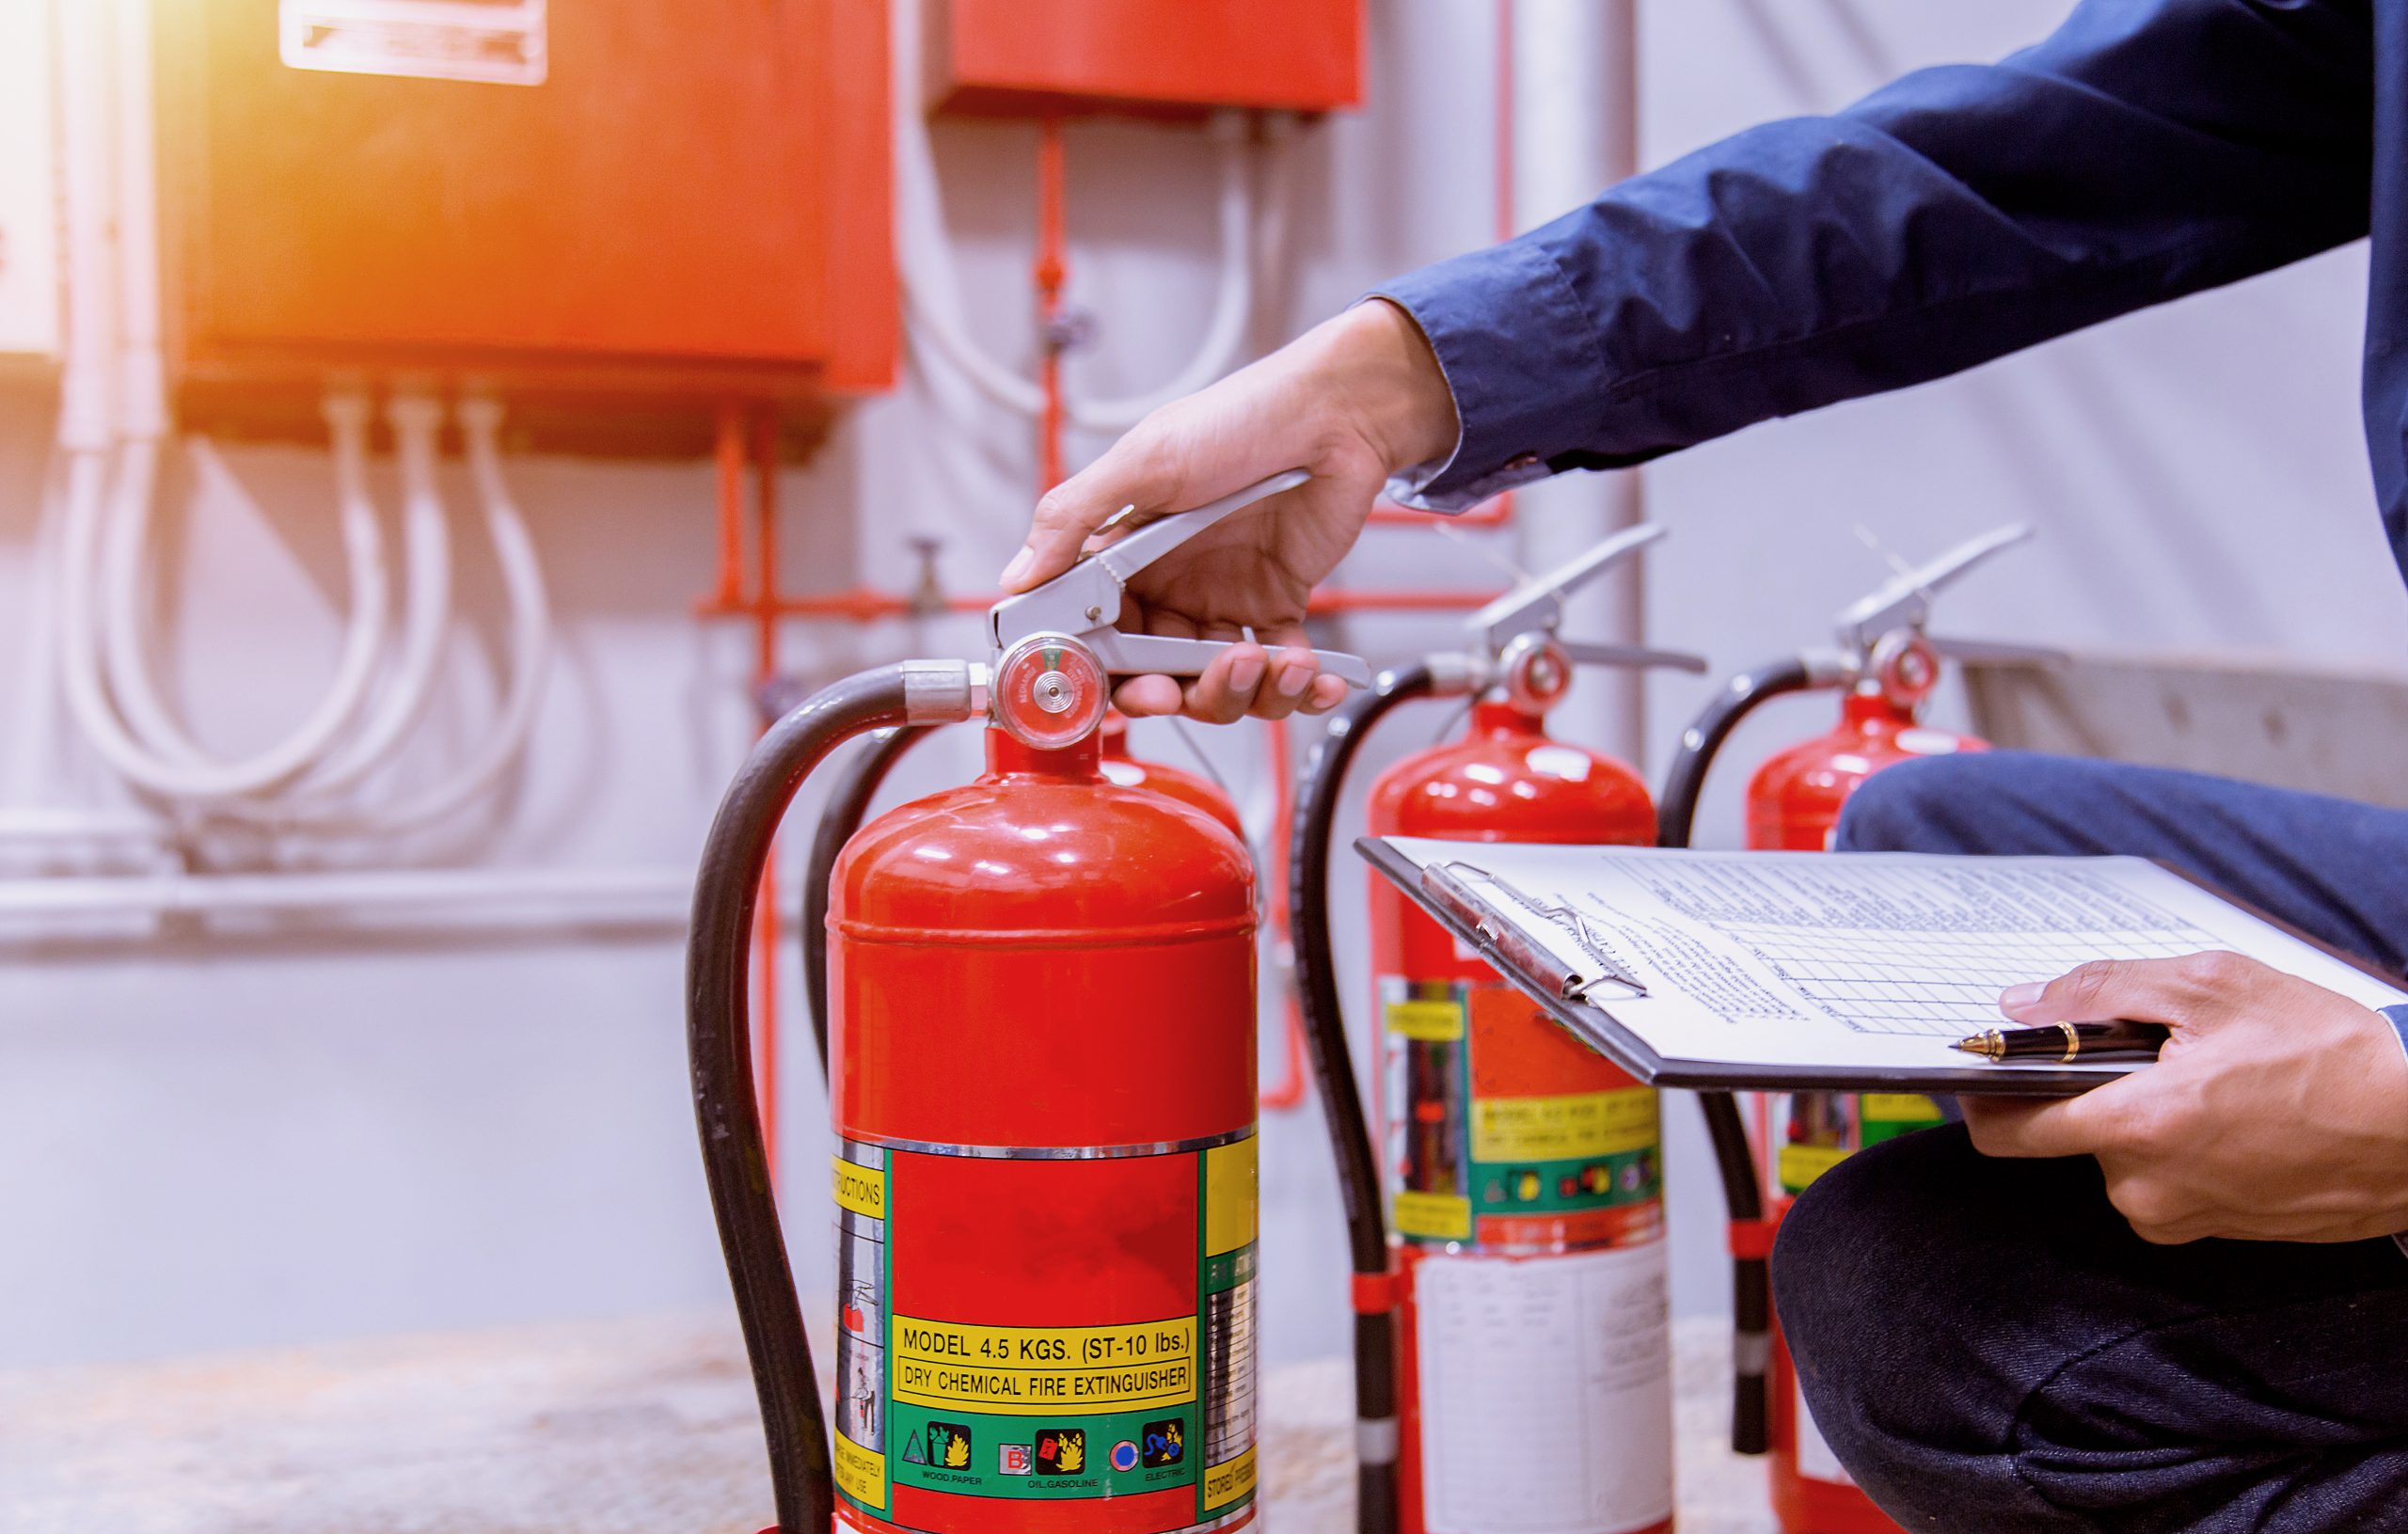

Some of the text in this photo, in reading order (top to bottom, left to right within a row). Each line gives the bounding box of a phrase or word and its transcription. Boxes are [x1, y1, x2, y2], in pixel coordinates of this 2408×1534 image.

[904, 1327, 1190, 1364] MODEL 4.5 KGS. (ST-10 lbs.)
[905, 1366, 1186, 1396] DRY CHEMICAL FIRE EXTINGUISHER
[1007, 1450, 1024, 1469] B
[1144, 1467, 1186, 1482] ELECTRIC
